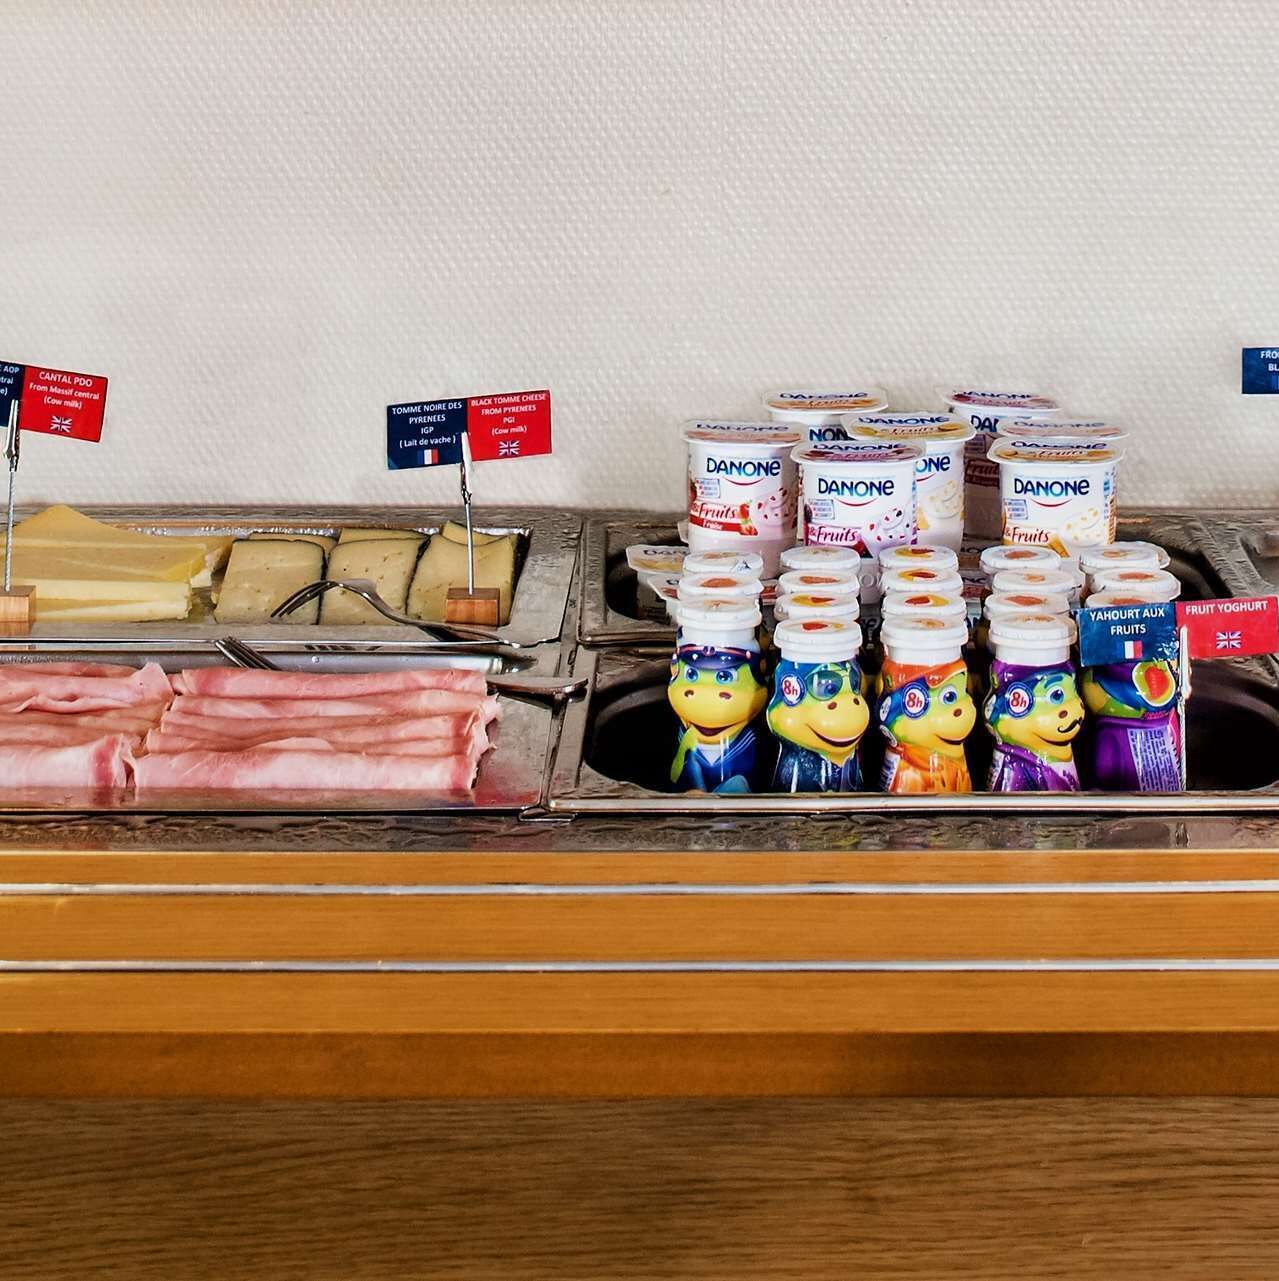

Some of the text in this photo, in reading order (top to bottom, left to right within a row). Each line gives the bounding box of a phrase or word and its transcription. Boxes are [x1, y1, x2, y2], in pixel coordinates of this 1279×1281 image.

[3, 365, 20, 375] AOP
[39, 371, 93, 387] CANTAL PDO
[29, 382, 100, 400] From Massif central
[44, 396, 83, 410] (Cow milk)
[471, 394, 546, 407] BLACK TOMME CHEESE
[392, 402, 463, 415] TOMME NOIRE DES
[481, 405, 537, 416] FROM PYRENEES
[409, 414, 446, 424] PYRENEES
[492, 425, 528, 436] (Cow milk)
[419, 438, 428, 446] de
[1090, 608, 1165, 621] YAHOURT AUX
[1185, 601, 1268, 615] FRUIT YOGHURT
[1110, 624, 1147, 636] FRUITS
[783, 680, 799, 696] 8h
[906, 692, 923, 708] 8h
[1010, 692, 1027, 708] 8h
